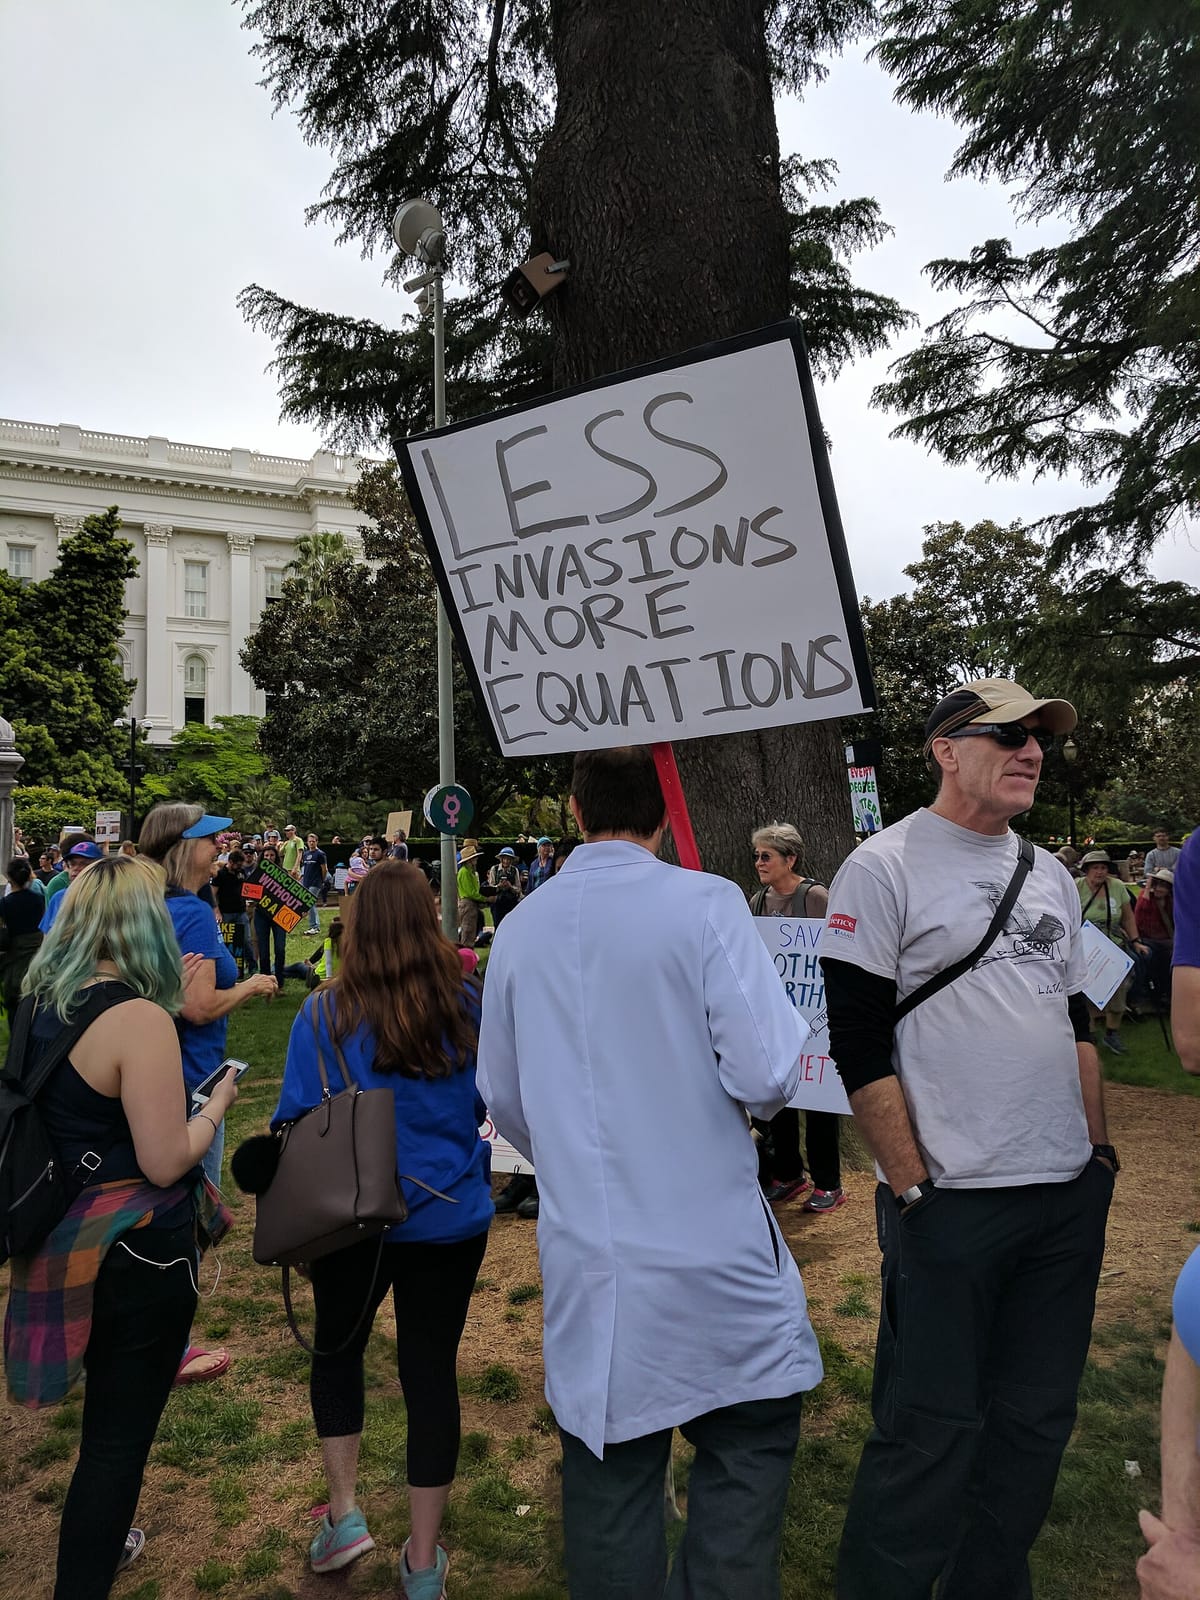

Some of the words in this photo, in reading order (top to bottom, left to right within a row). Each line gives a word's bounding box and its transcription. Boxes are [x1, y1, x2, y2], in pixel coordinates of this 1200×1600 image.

[422, 391, 728, 560] LESS
[449, 506, 798, 614] INVASIONS
[484, 580, 694, 673] MORE
[485, 634, 853, 744] EQUATIONS
[258, 872, 303, 910] WITHOUT
[260, 859, 317, 907] CONSCIENCE
[259, 895, 271, 908] IS
[267, 903, 279, 915] A
[830, 915, 855, 929] ience
[779, 923, 822, 948] SAV
[773, 952, 823, 980] OTH
[785, 981, 824, 1009] RTH
[800, 1054, 830, 1084] ET
